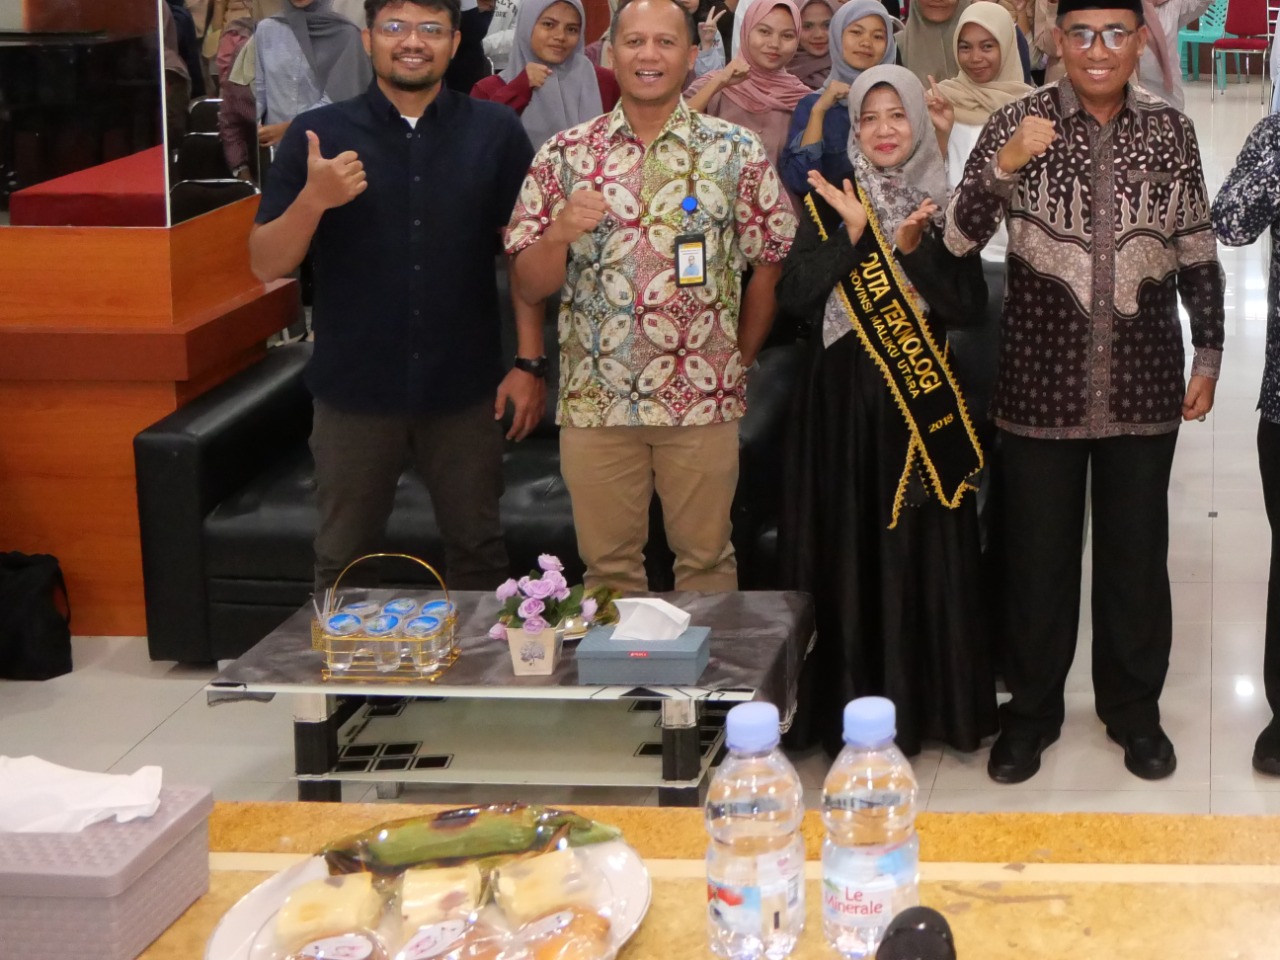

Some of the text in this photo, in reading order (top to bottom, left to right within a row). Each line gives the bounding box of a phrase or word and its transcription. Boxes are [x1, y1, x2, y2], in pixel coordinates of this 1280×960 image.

[849, 268, 920, 399] ROVINSI MALUKU UTARA
[880, 298, 943, 394] TEKNOLOGI
[845, 886, 863, 902] Le
